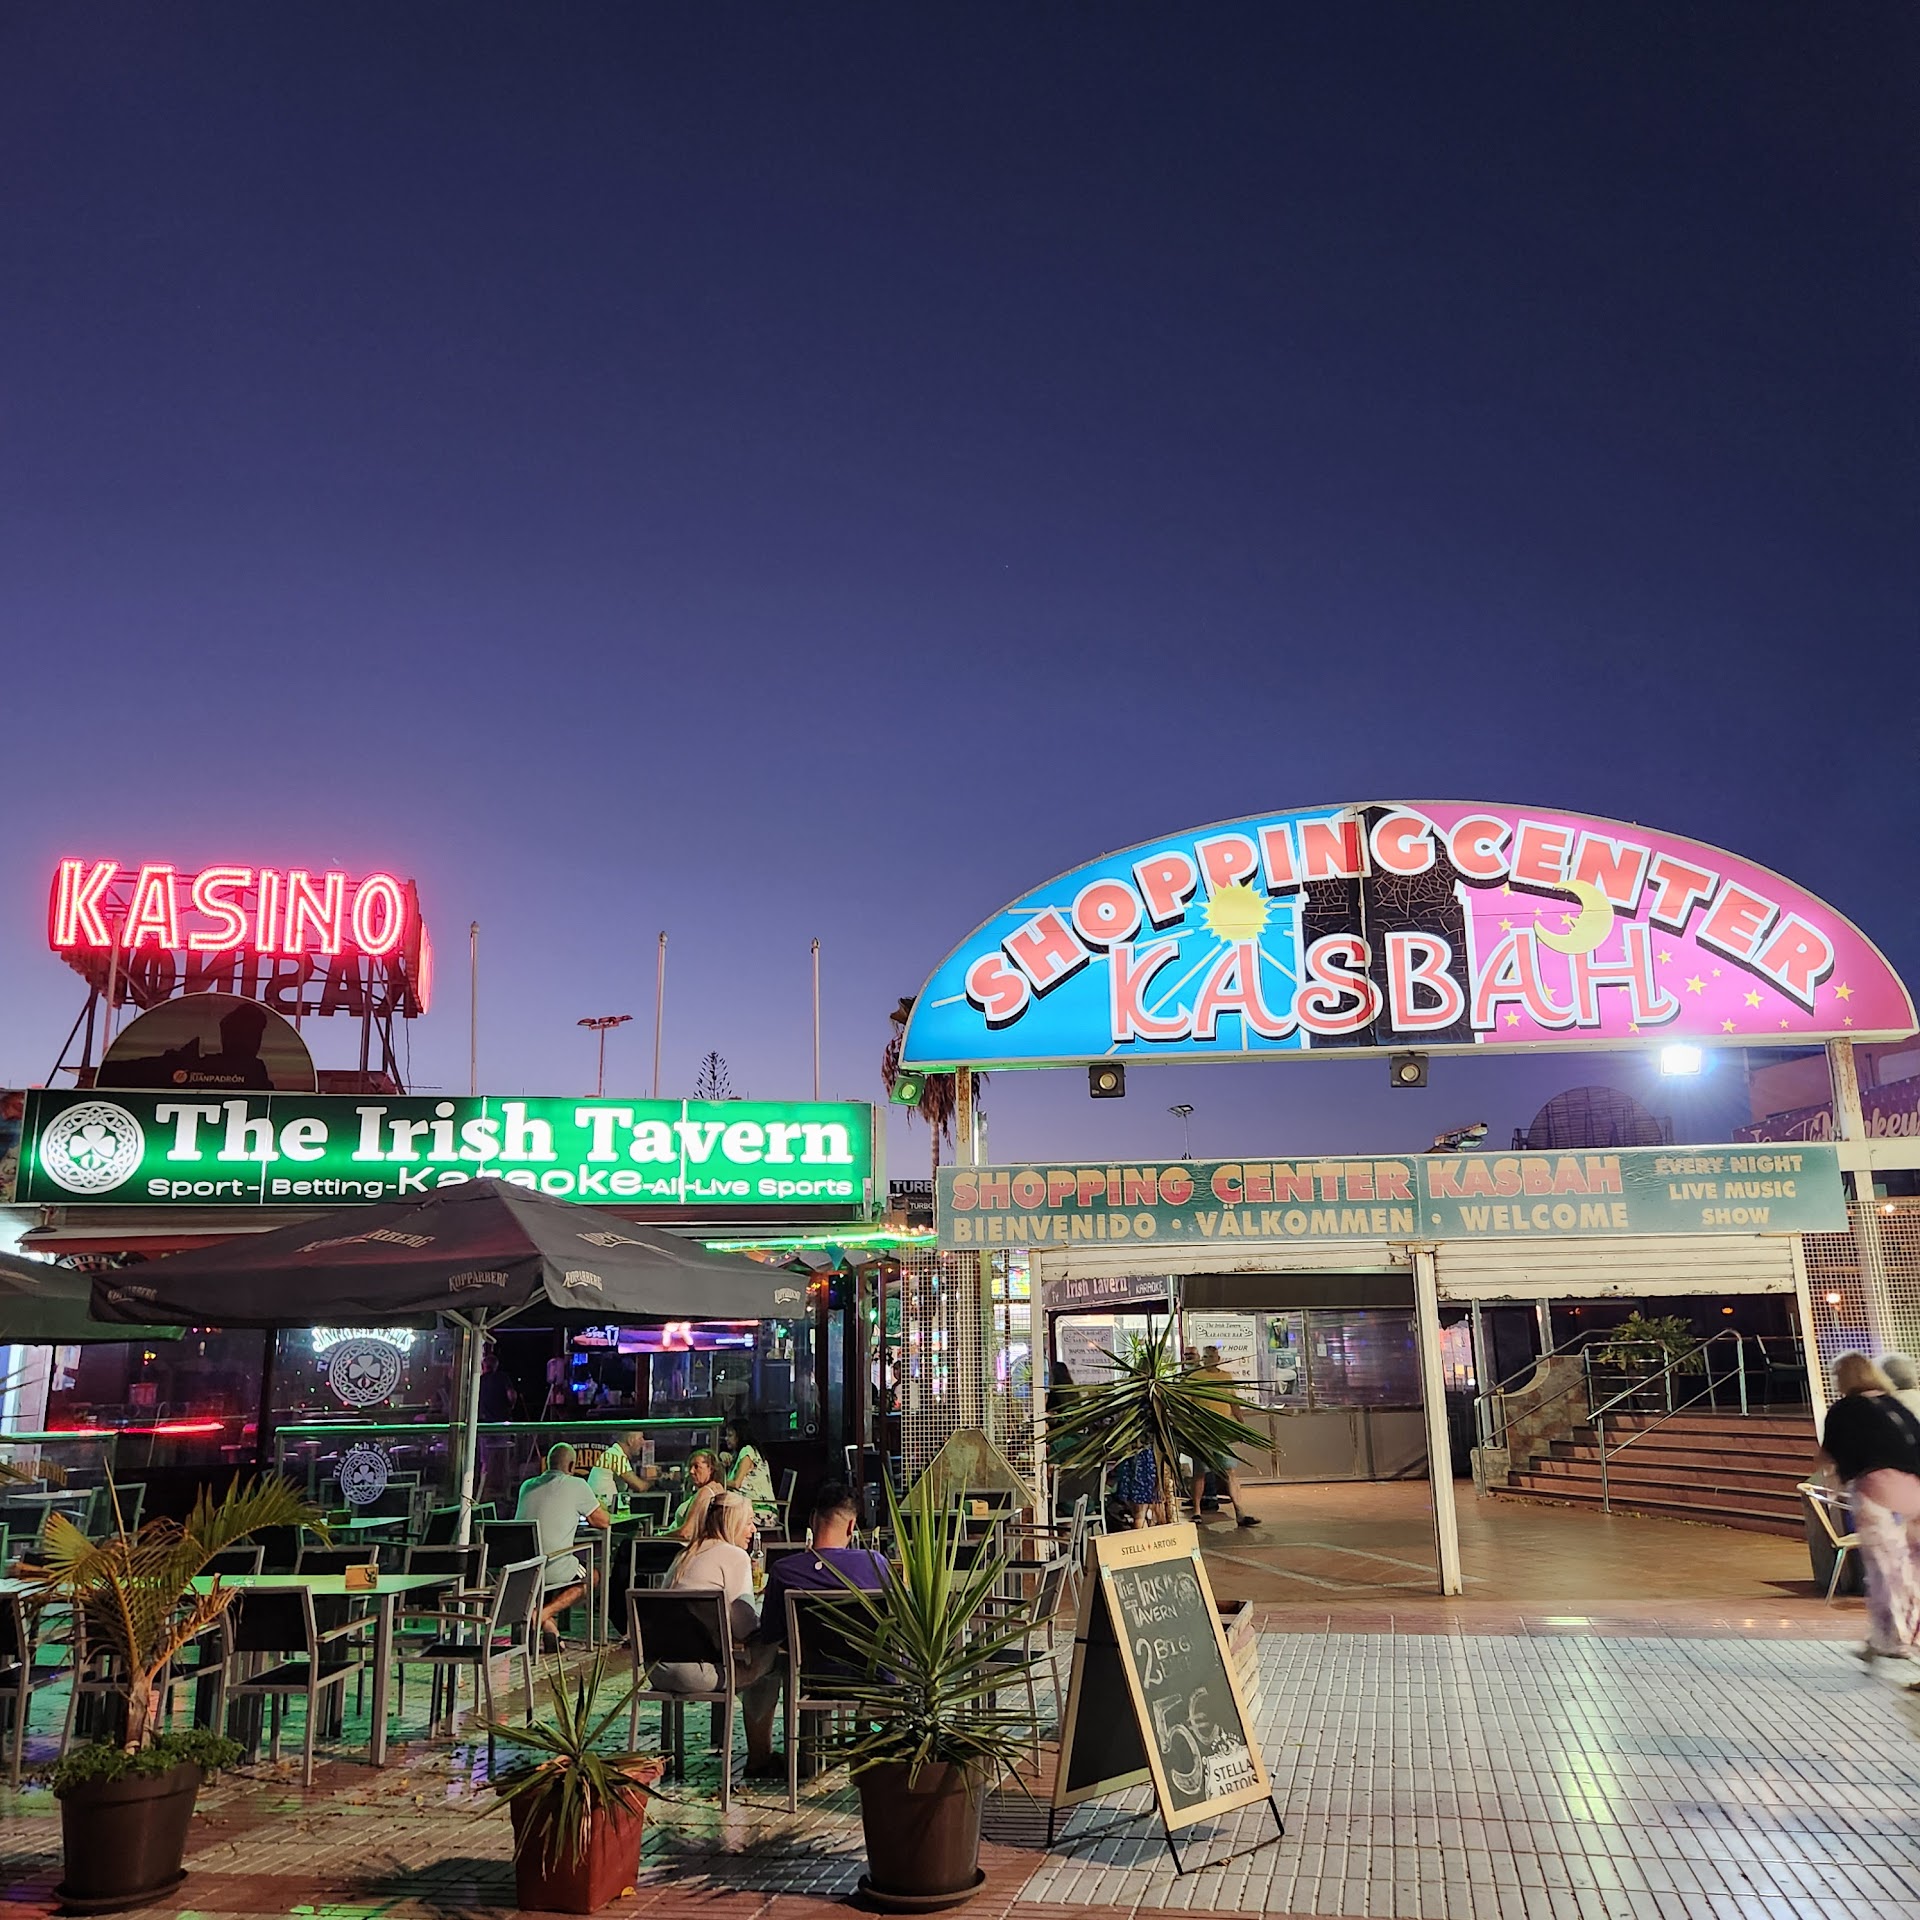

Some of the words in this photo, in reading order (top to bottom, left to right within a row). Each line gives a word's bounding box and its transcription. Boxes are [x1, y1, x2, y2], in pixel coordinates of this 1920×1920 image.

[52, 858, 407, 955] KASINO
[966, 811, 1437, 1026] SHOPPING
[1445, 814, 1834, 1012] CENTER
[1110, 922, 1680, 1041] KASBAH
[155, 1099, 329, 1162] The
[352, 1101, 558, 1162] Irish
[574, 1106, 854, 1164] Tavern
[1655, 1157, 1727, 1176] EVERY
[1731, 1154, 1803, 1173] NIGHT
[758, 1178, 853, 1199] Sports
[951, 1168, 1193, 1210] SHOPPING
[1212, 1161, 1413, 1204] CENTER
[1427, 1155, 1624, 1199] KASBAH
[1669, 1182, 1718, 1200] LIVE
[1725, 1180, 1796, 1199] MUSIC
[953, 1212, 1157, 1243] BIENVENIDO
[1195, 1204, 1414, 1237] VÄLKOMMEN
[1459, 1202, 1629, 1232] WELCOME
[1702, 1206, 1770, 1225] SHOW
[1066, 1279, 1090, 1299] Irish
[1135, 1281, 1164, 1295] KARAOKE
[1121, 1544, 1146, 1556] STELLA
[1153, 1538, 1177, 1549] ARTOIS
[1153, 1635, 1191, 1661] BIG
[1213, 1758, 1255, 1782] STELLA
[1219, 1773, 1260, 1796] ARTOIS
